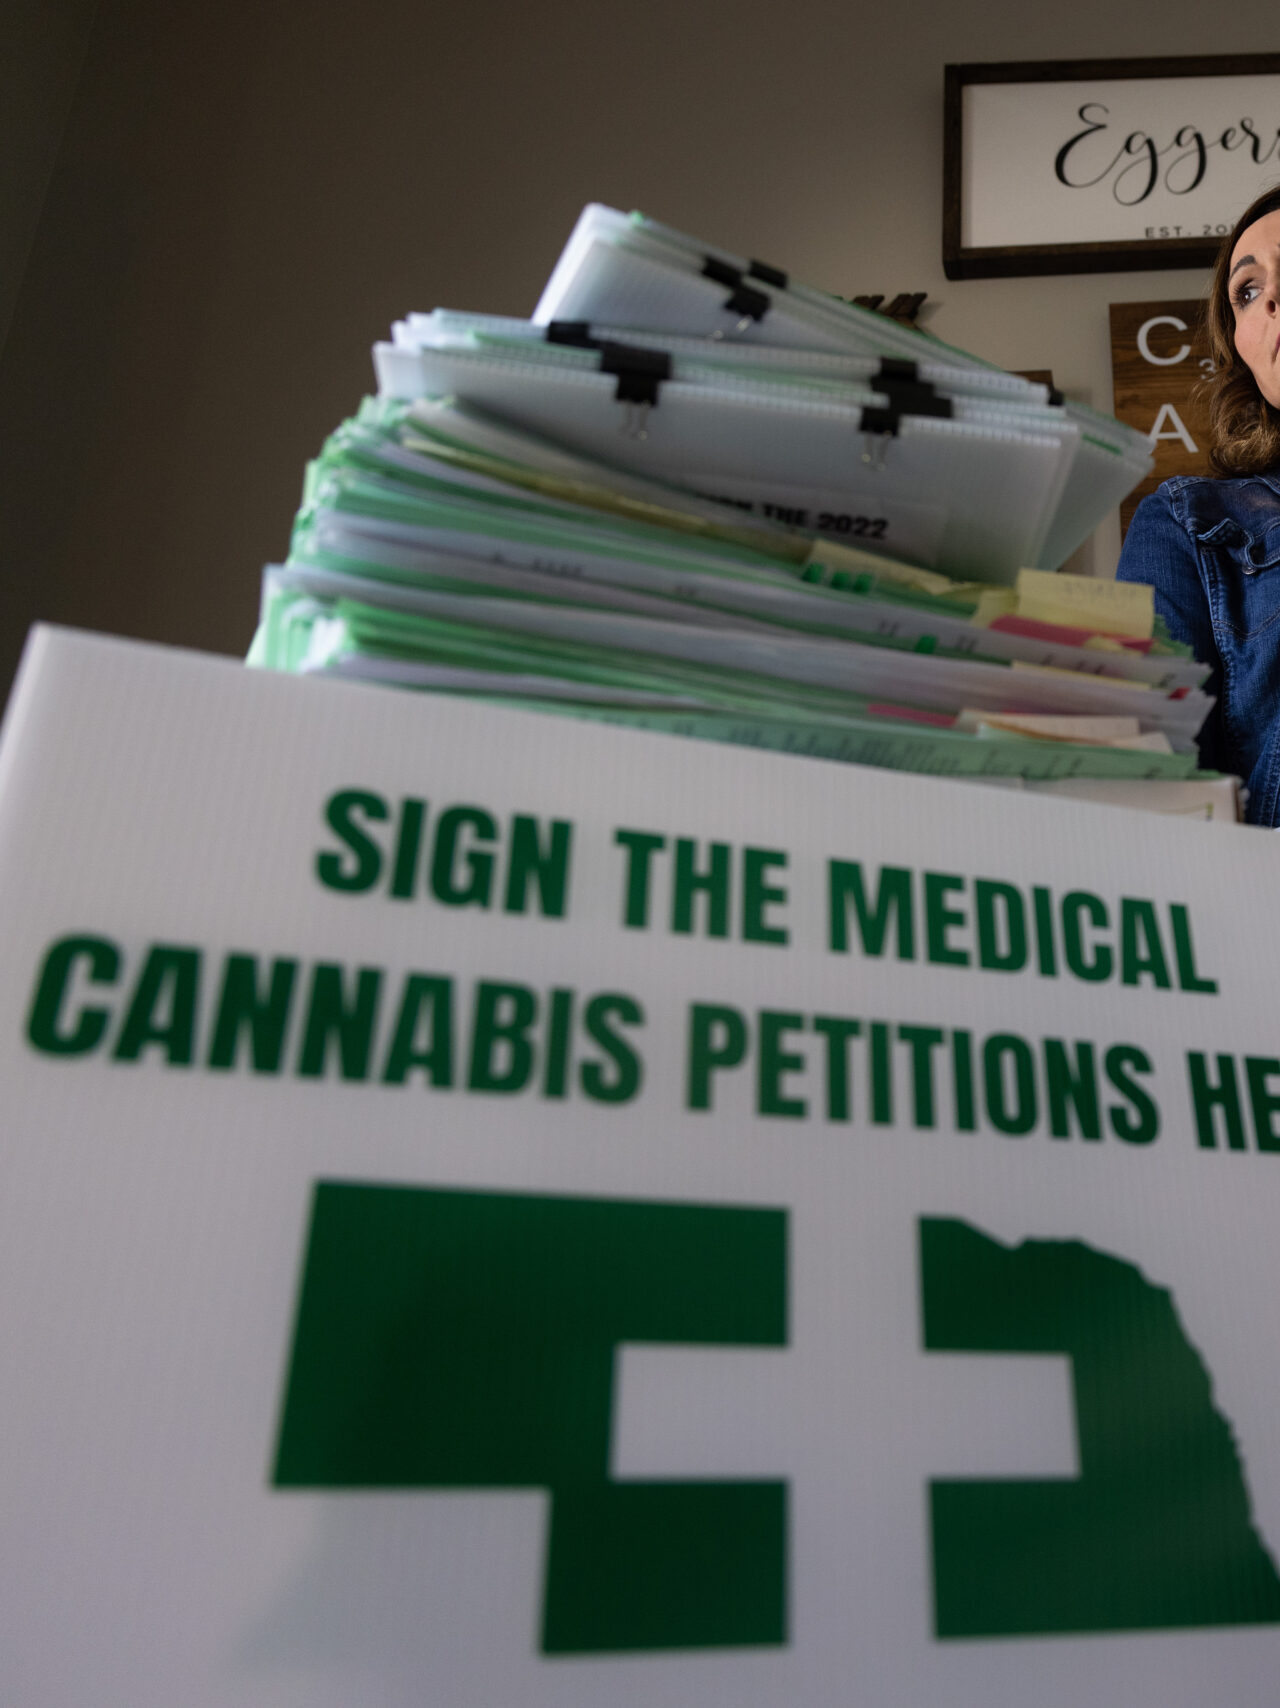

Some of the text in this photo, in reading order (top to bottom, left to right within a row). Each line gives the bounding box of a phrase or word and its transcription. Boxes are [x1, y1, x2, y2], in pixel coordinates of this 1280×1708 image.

[1145, 225, 1192, 238] EST.
[1137, 315, 1191, 366] C
[1149, 403, 1199, 453] A
[817, 512, 888, 540] 2022
[314, 787, 1218, 995] SIGN THE MEDICAL
[26, 933, 646, 1106] CANNABIS
[686, 1003, 1161, 1146] PETITIONS
